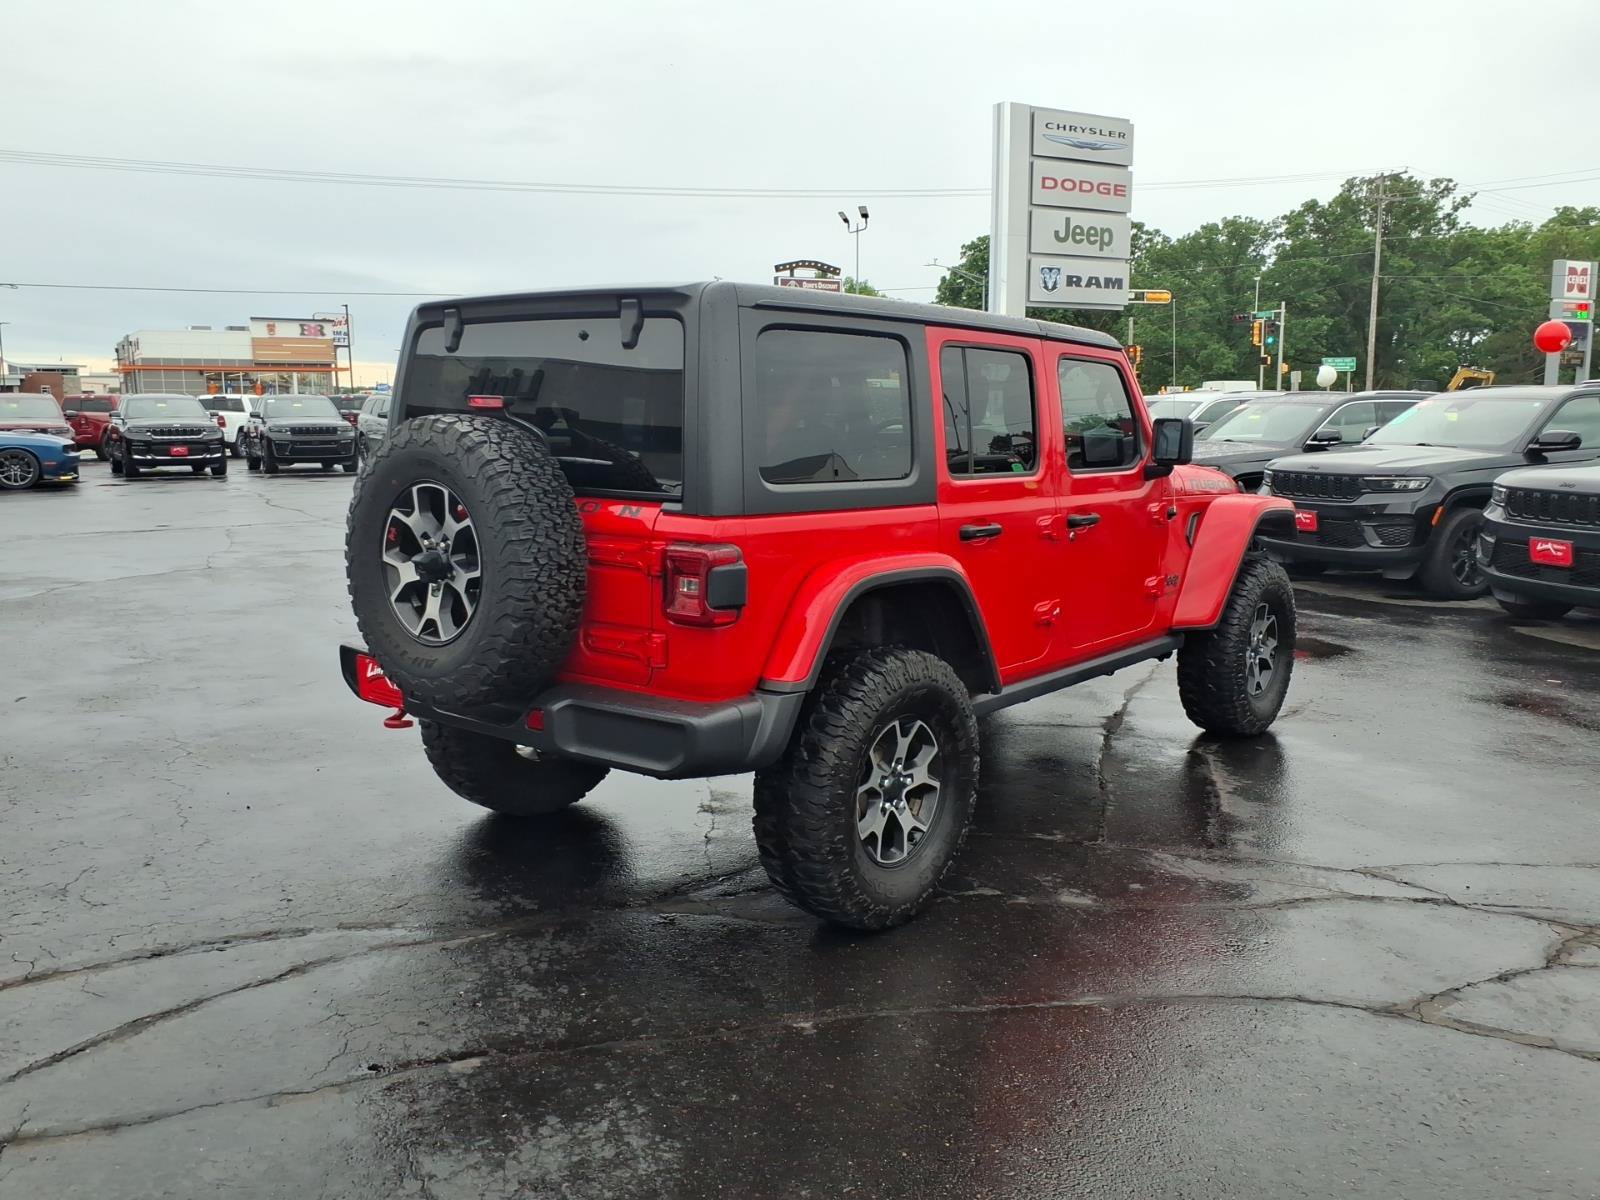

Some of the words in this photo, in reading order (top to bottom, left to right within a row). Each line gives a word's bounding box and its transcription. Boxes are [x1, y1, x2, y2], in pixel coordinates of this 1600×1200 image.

[1045, 122, 1127, 140] CHRYSLER
[1041, 176, 1127, 197] DODGE
[1054, 216, 1114, 252] Jeep
[1065, 275, 1124, 290] RAM
